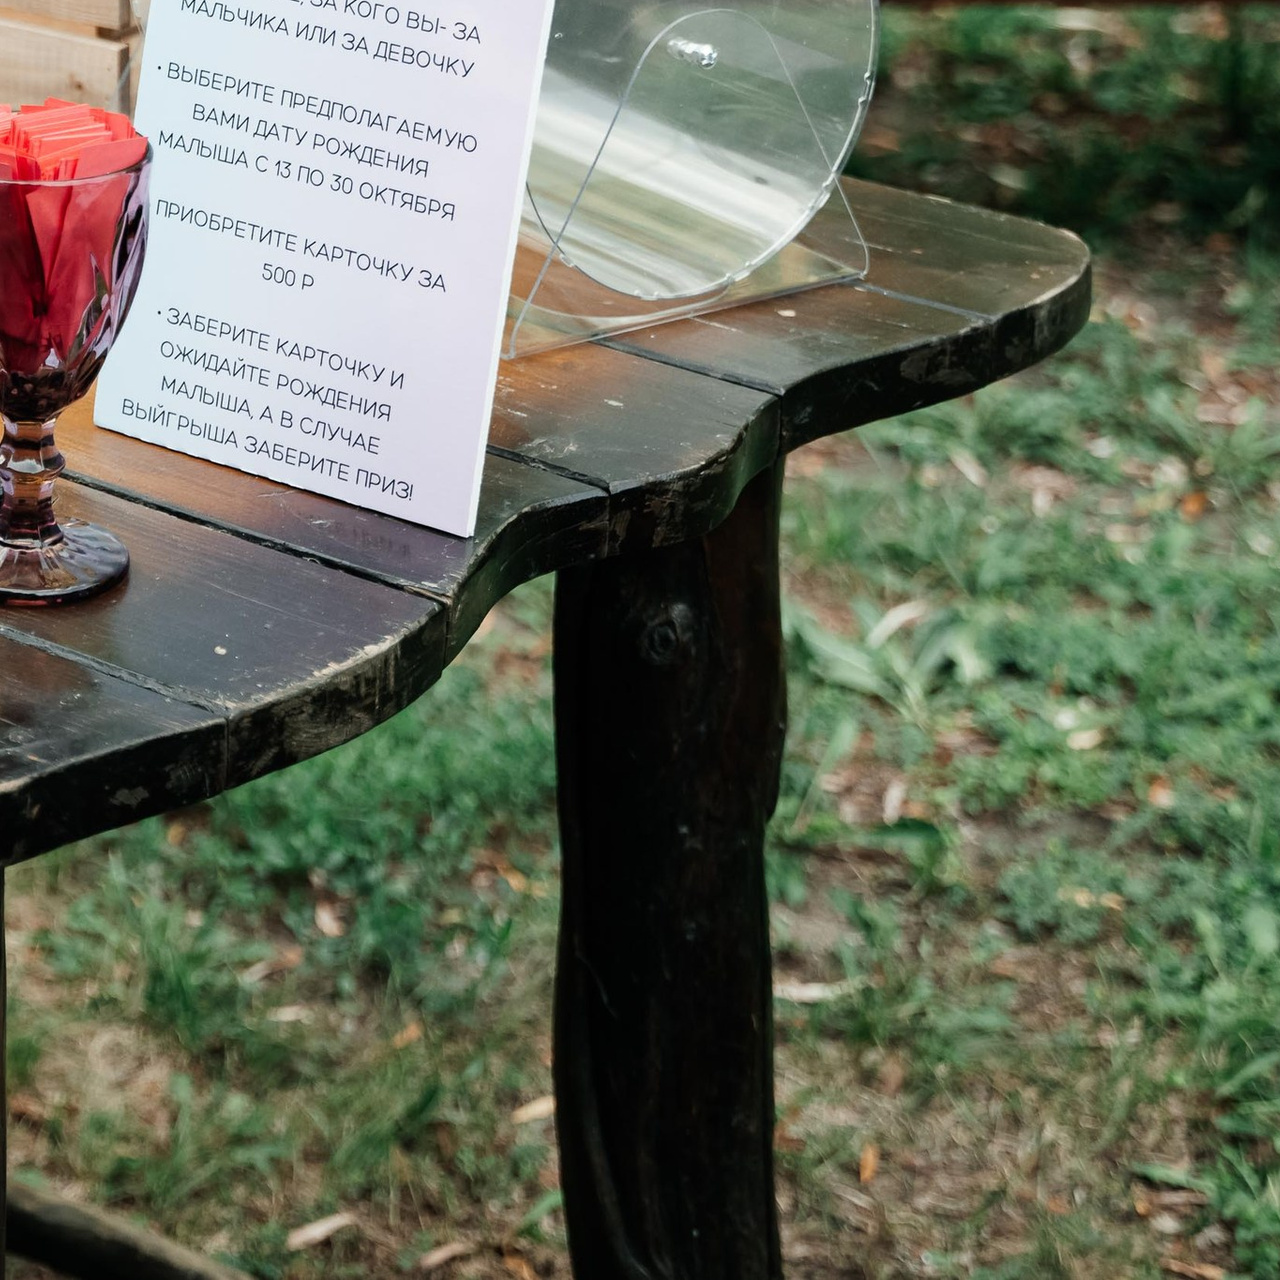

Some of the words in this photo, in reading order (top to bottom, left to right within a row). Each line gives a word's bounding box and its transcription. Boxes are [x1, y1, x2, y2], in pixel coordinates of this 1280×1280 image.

[296, 20, 337, 47] ИЛИ
[340, 31, 369, 55] ЗА
[373, 40, 475, 78] ДЕВОЧКУ
[452, 22, 480, 44] ЗА
[167, 62, 275, 104] ВЫБЕРИТЕ
[280, 90, 477, 152] ПРЕДПОЛАГАЕМУЮ
[193, 103, 250, 135] ВАМИ
[253, 120, 308, 146] ДАТУ
[313, 133, 429, 178] РОЖДЕНИЯ
[159, 130, 249, 168] МАЛЫША
[255, 153, 269, 173] С
[273, 158, 293, 179] 13
[297, 163, 325, 187] ПО
[330, 173, 353, 194] 30
[359, 182, 455, 221] ОКТЯБРЯ
[156, 199, 297, 252] ПРИОБРЕТИТЕ
[303, 238, 414, 282] КАРТОЧКУ
[418, 270, 446, 293] ЗА
[262, 263, 296, 287] 500
[302, 273, 314, 290] Р
[160, 341, 270, 388] ОЖИДАЙТЕ
[276, 372, 392, 422] РОЖДЕНИЯ
[167, 307, 270, 352] ЗАБЕРИТЕ
[275, 338, 387, 387] КАРТОЧКУ
[390, 370, 404, 390] И
[122, 398, 239, 449] ВЫЙГРЫША
[243, 435, 350, 482] ЗАБЕРИТЕ
[356, 467, 413, 501] ПРИЗ!
[160, 375, 255, 421] МАЛЫША,
[259, 404, 274, 424] А
[280, 409, 294, 429] В
[298, 415, 381, 455] СЛУЧАЕ
